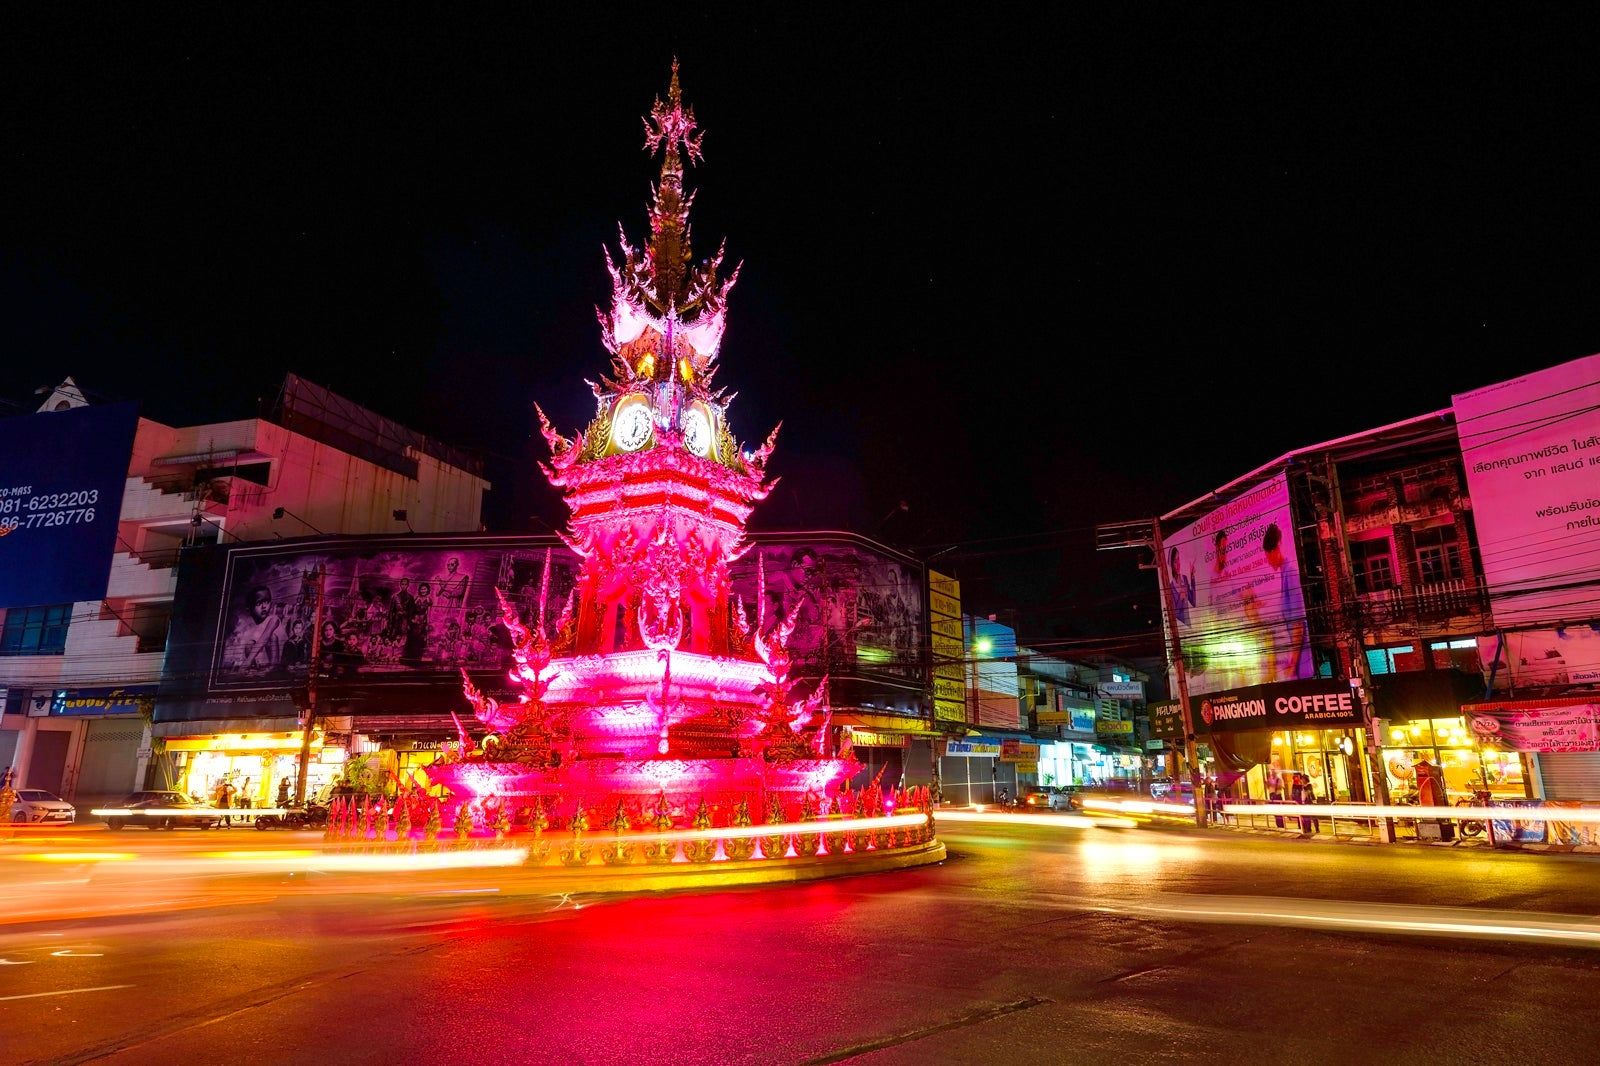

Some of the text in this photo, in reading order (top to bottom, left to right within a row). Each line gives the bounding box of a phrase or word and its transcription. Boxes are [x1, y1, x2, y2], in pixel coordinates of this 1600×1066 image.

[1472, 444, 1569, 474] เลือกคุณภาพชีวิต
[1523, 467, 1546, 480] จาก
[1550, 457, 1584, 475] แลนด์
[1213, 693, 1353, 720] PANGKHON COFFEE
[1304, 712, 1336, 720] ARABICA
